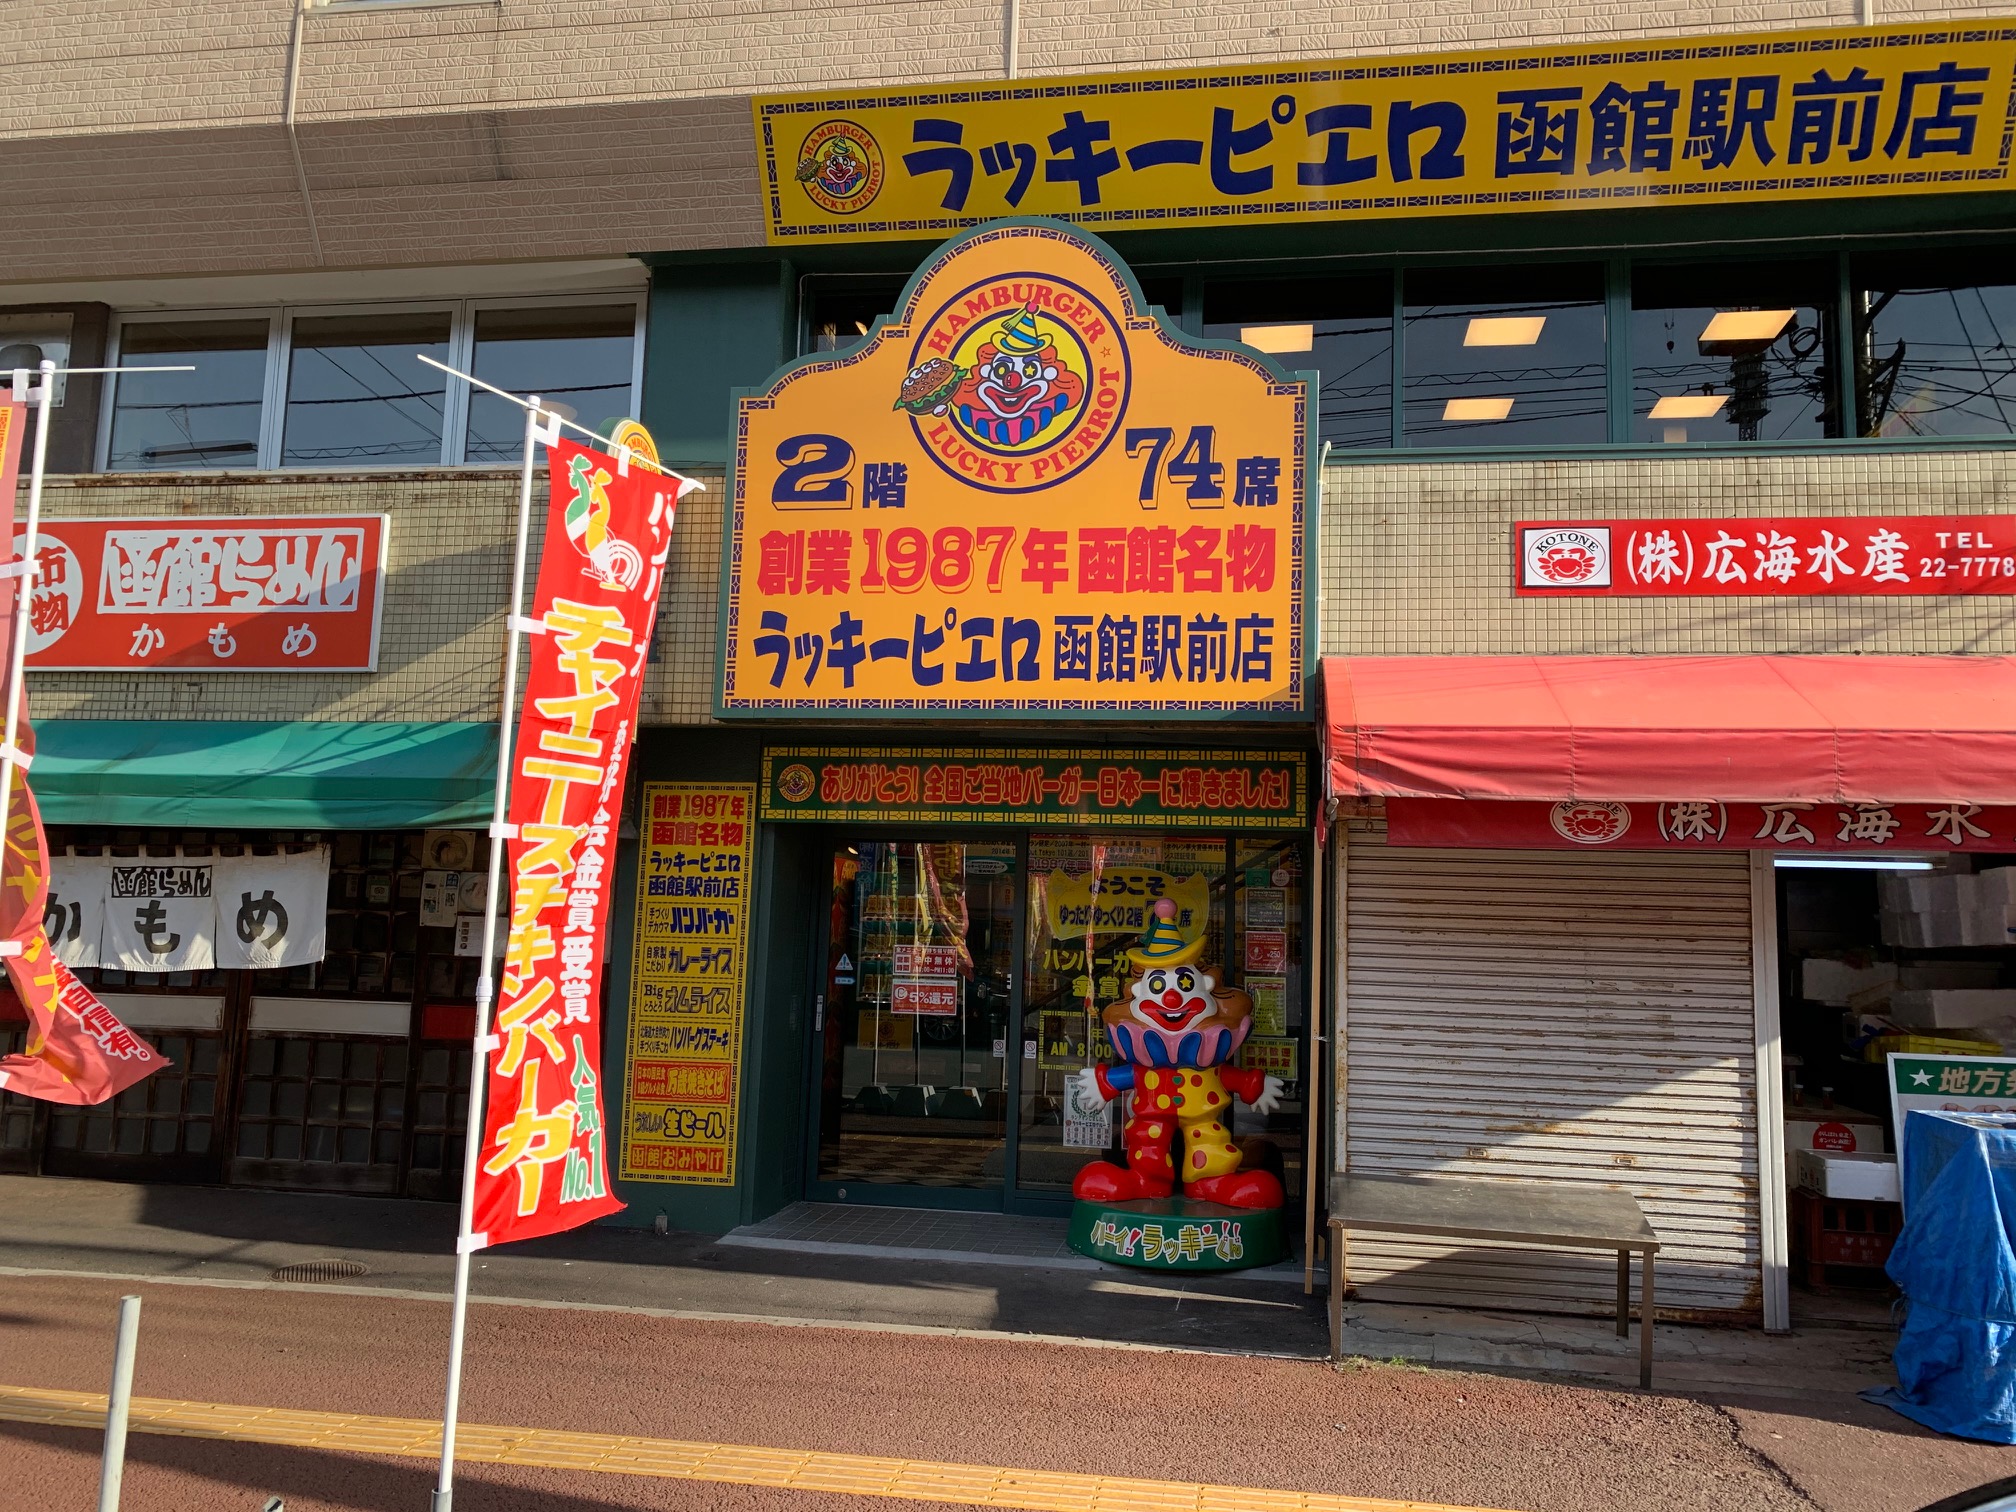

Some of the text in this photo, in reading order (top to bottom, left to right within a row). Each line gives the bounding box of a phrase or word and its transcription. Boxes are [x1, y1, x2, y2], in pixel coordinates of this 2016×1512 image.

[1493, 60, 1991, 180] 函館駅前店
[804, 124, 874, 157] HAMBURGER
[809, 159, 881, 211] LUCKY PIERROT
[928, 283, 1106, 355] HAMBURGER
[926, 366, 1121, 484] LUCKY PIERROT
[771, 424, 1282, 511] 2階 74席
[1536, 531, 1599, 556] KOTONE
[1935, 531, 1994, 550] TEL
[1919, 556, 2015, 579] 22-7778
[652, 794, 745, 821] 創業1987年
[651, 822, 744, 847] 函館名物
[650, 850, 741, 874] ラッキーピエロ
[648, 875, 740, 898] 函館駅前店
[666, 946, 734, 976] カレーライス
[644, 984, 665, 1000] Big
[664, 985, 732, 1016] オムライス
[1050, 1041, 1069, 1057] AM
[663, 1107, 726, 1140] 生ビール
